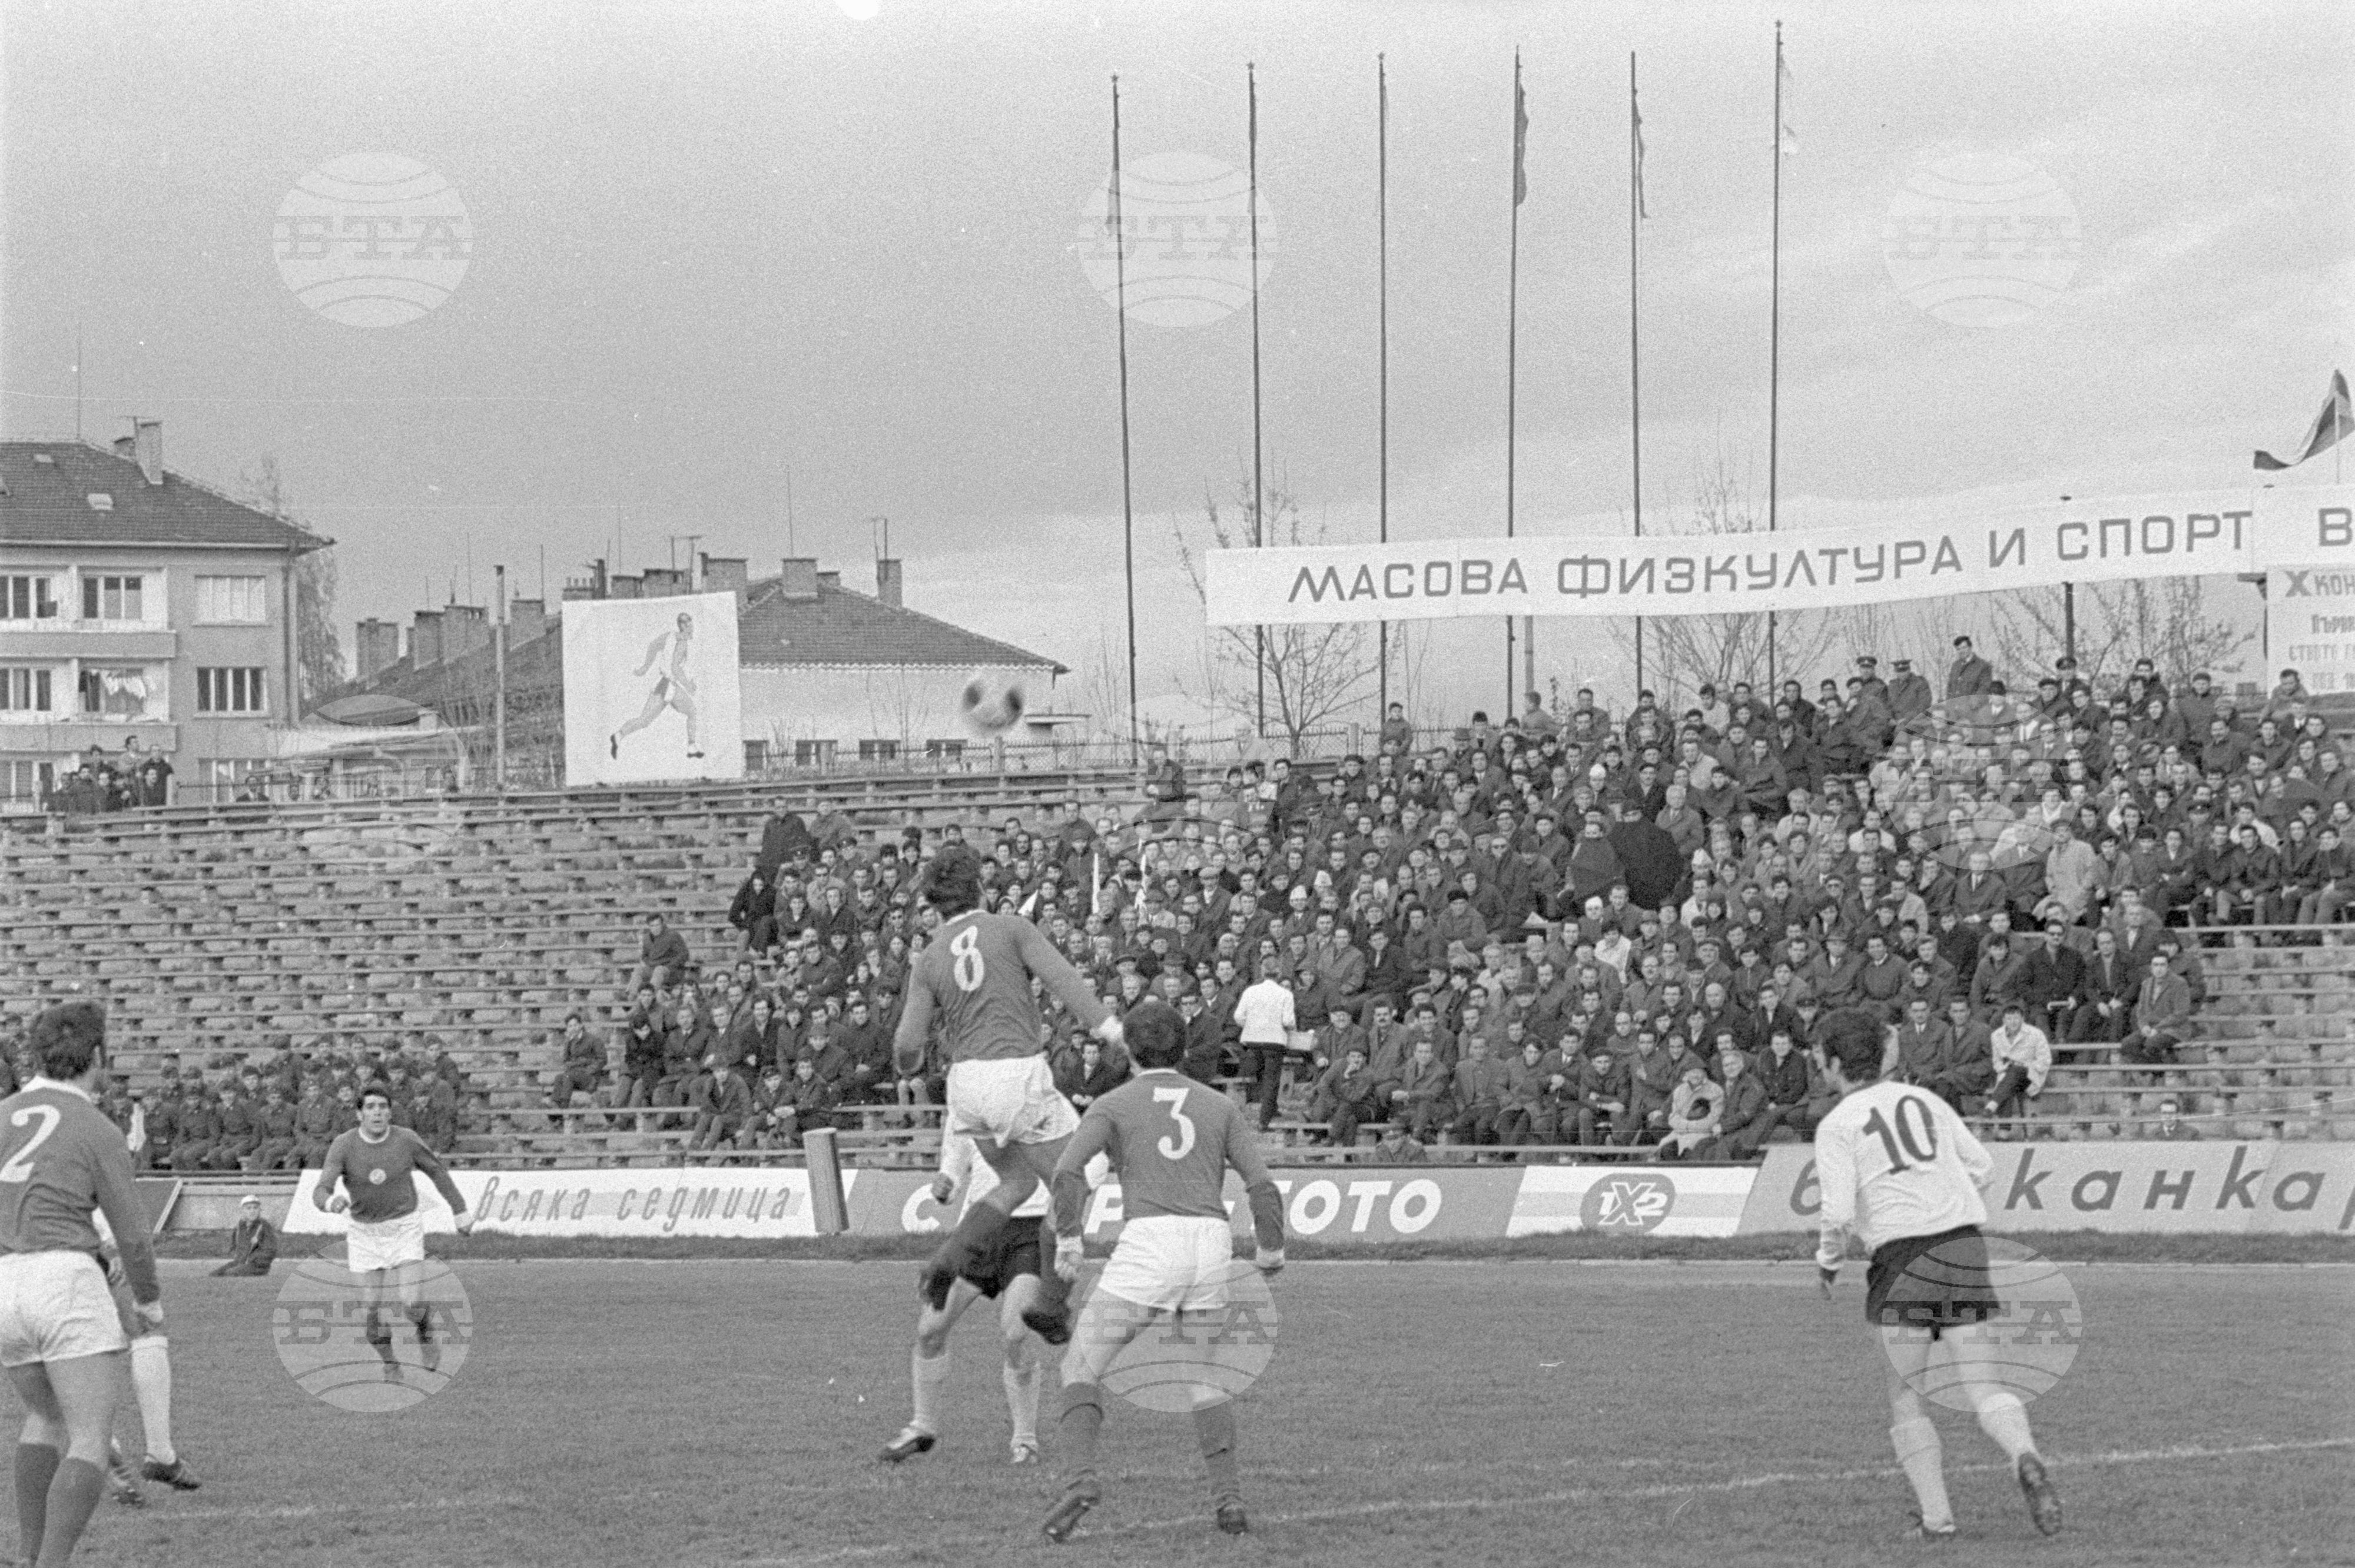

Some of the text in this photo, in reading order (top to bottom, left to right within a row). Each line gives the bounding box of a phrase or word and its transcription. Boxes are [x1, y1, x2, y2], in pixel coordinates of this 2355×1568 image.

[1288, 557, 1528, 603] МАСОВА
[1557, 535, 1963, 599] ФИЗКУЛТУРА
[1989, 527, 2025, 568] И
[2057, 510, 2253, 561] СПОРТ
[951, 925, 984, 991] 8
[0, 1104, 61, 1182] 2
[1153, 1087, 1195, 1160] 3
[1863, 1095, 1937, 1175] 10
[616, 1187, 791, 1233] седмица
[1598, 1182, 1668, 1226] 1X2
